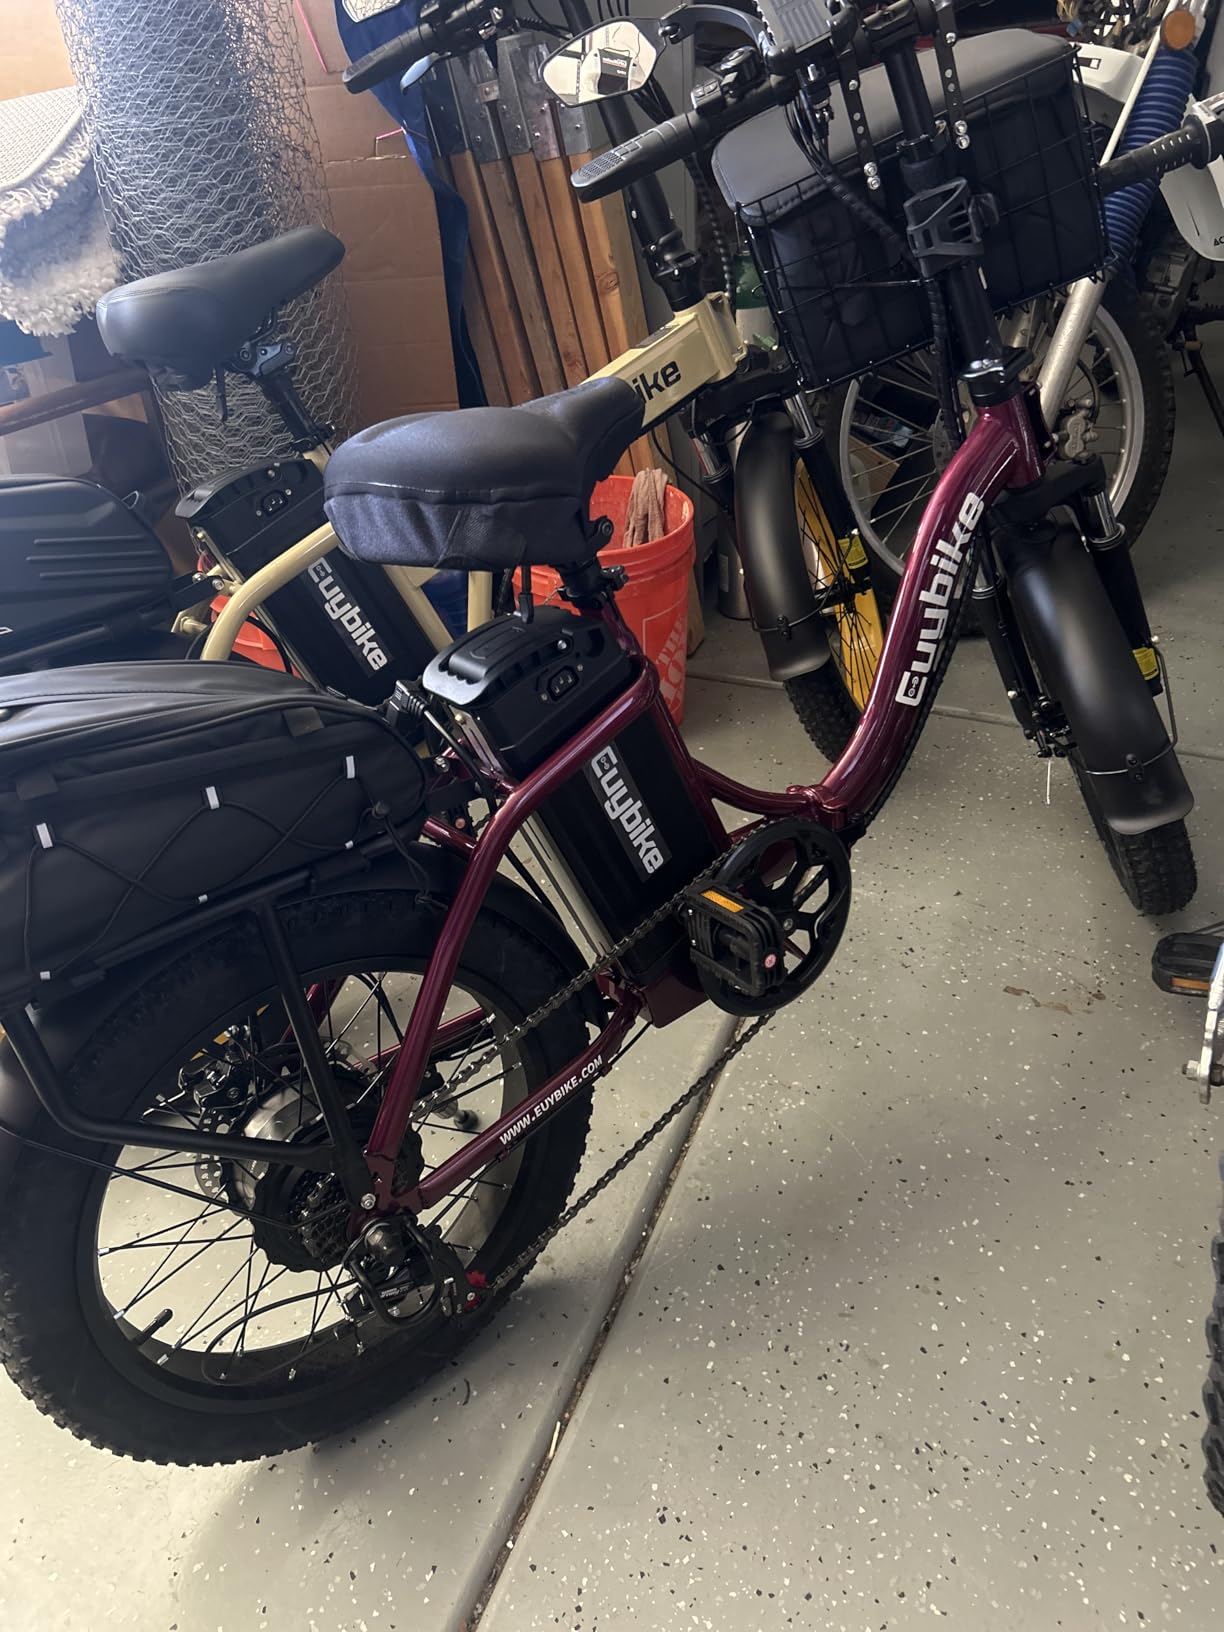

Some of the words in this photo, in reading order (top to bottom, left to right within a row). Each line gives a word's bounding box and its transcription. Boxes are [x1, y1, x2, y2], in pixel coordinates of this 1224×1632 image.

[307, 556, 388, 671] Euybike
[895, 492, 985, 707] Euybike
[591, 745, 664, 874] Euybike
[499, 1054, 603, 1145] WWW.EUYBIKE.COM
